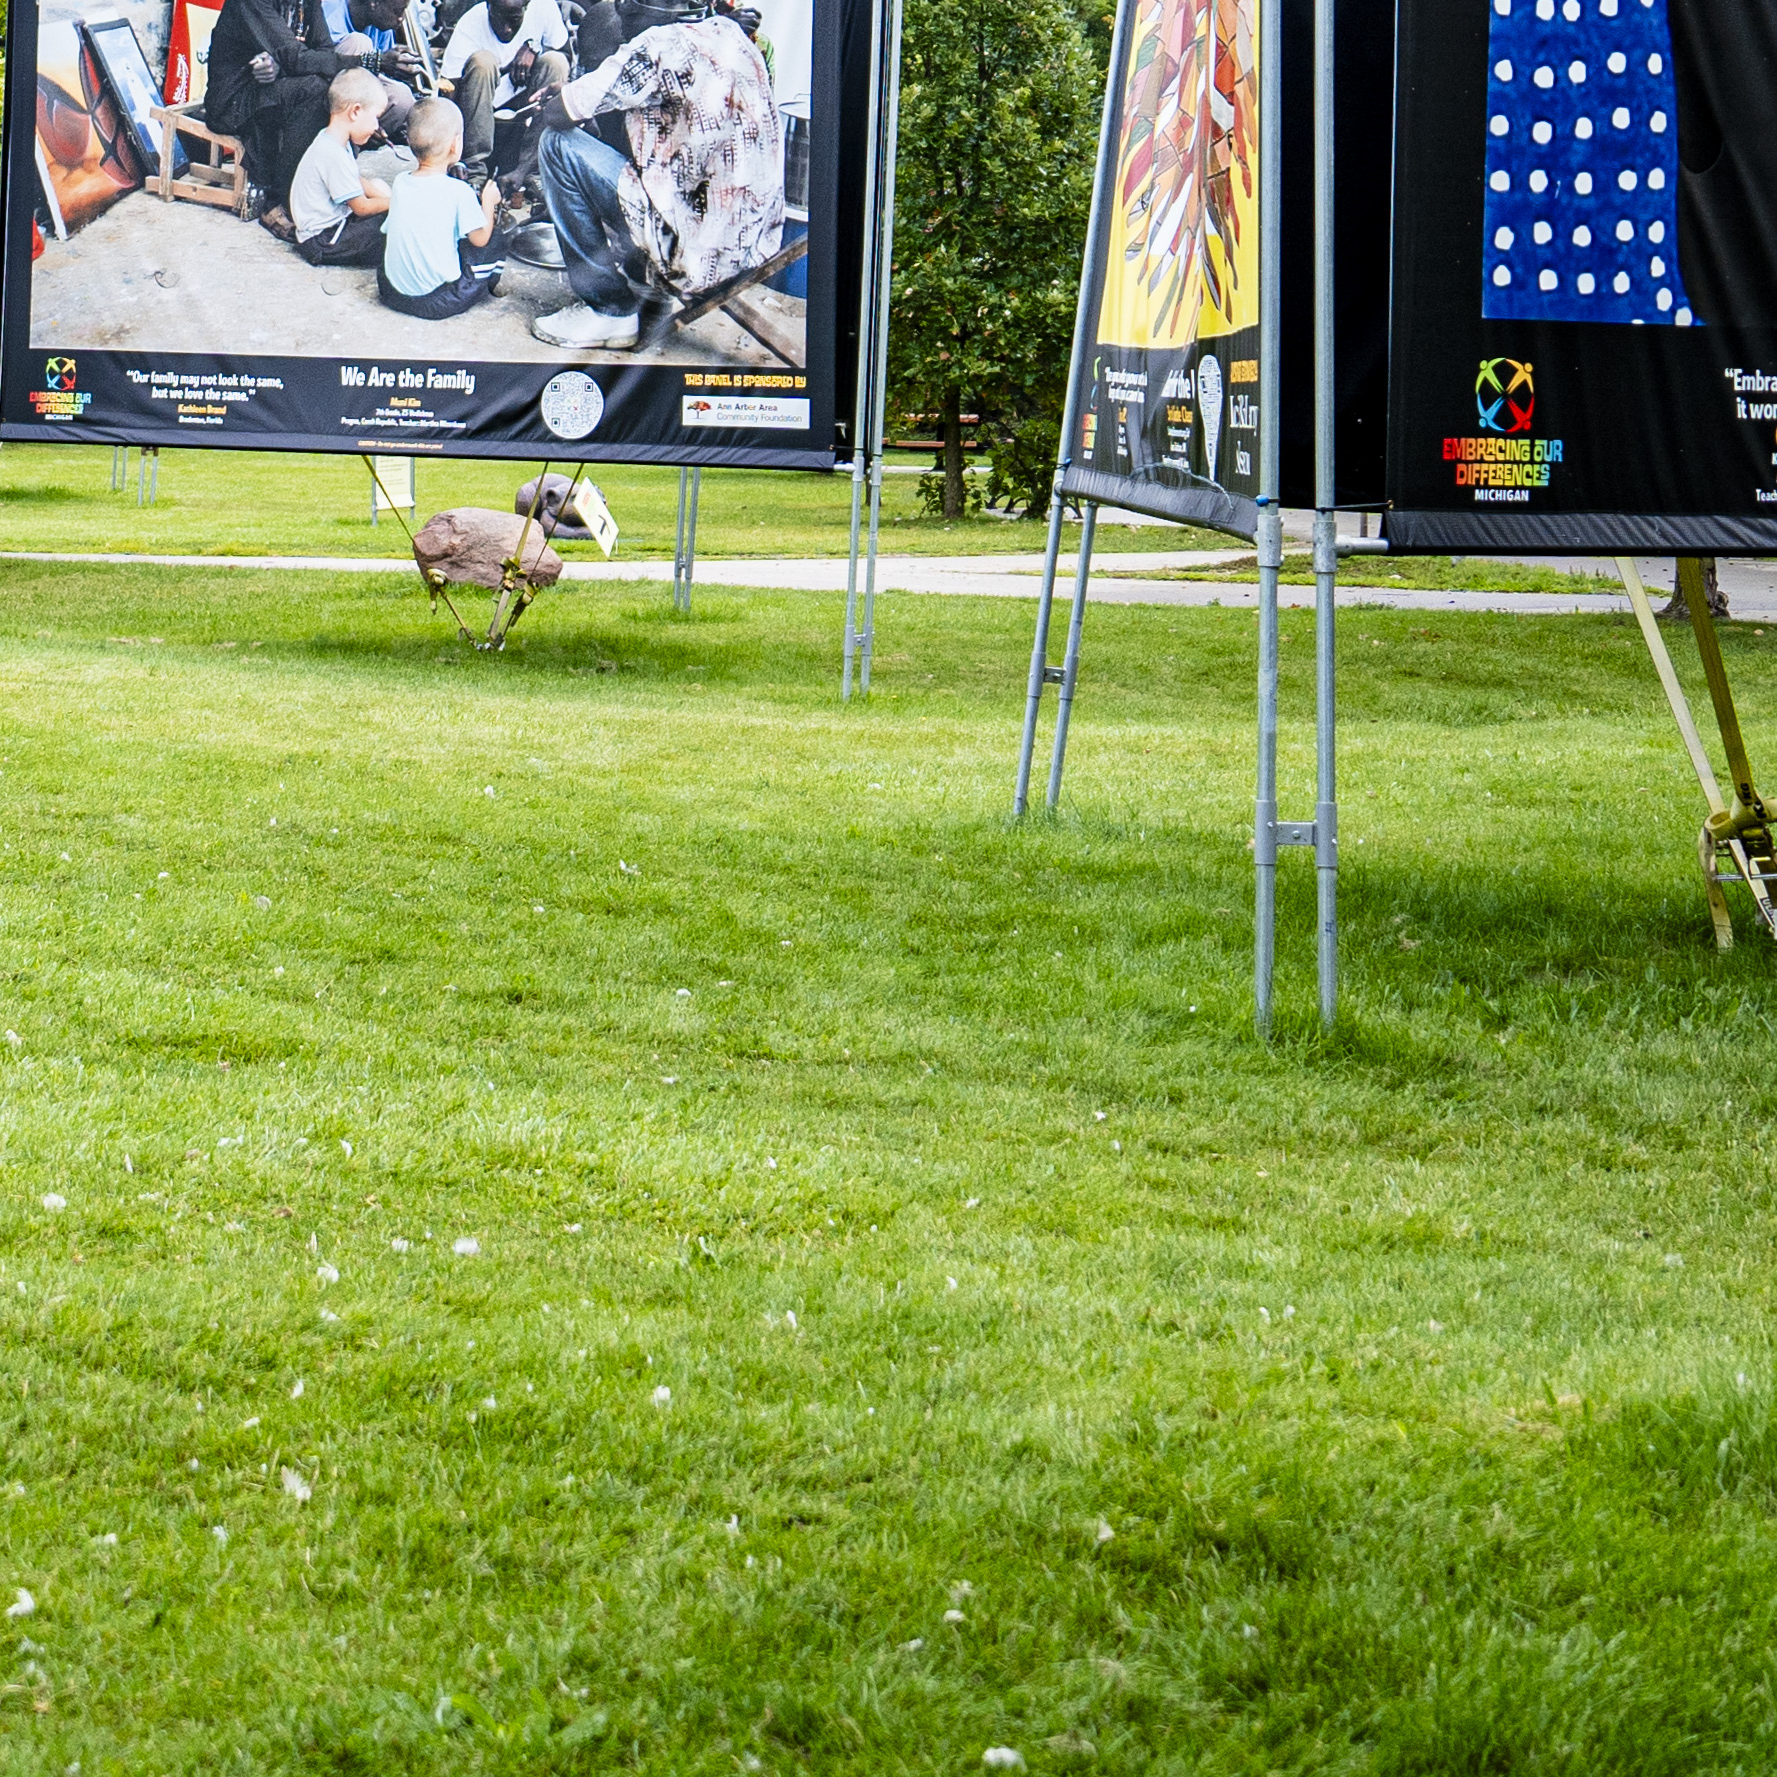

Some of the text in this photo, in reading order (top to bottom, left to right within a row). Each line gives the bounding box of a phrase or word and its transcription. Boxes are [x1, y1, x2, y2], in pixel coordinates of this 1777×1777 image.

[126, 370, 284, 389] “Our family may not look the same,
[341, 366, 476, 395] We Are the Family
[684, 374, 806, 388] THIS PANEL IS SPONSORED BY
[151, 386, 168, 398] but
[169, 389, 183, 399] we
[184, 387, 203, 400] love
[205, 388, 221, 400] the
[1736, 396, 1747, 419] it
[717, 412, 803, 423] Community Foundation
[1442, 437, 1563, 462] EMBRACING OUR
[1455, 463, 1551, 486] DIFFERENCES
[1474, 489, 1530, 502] MICHIGAN
